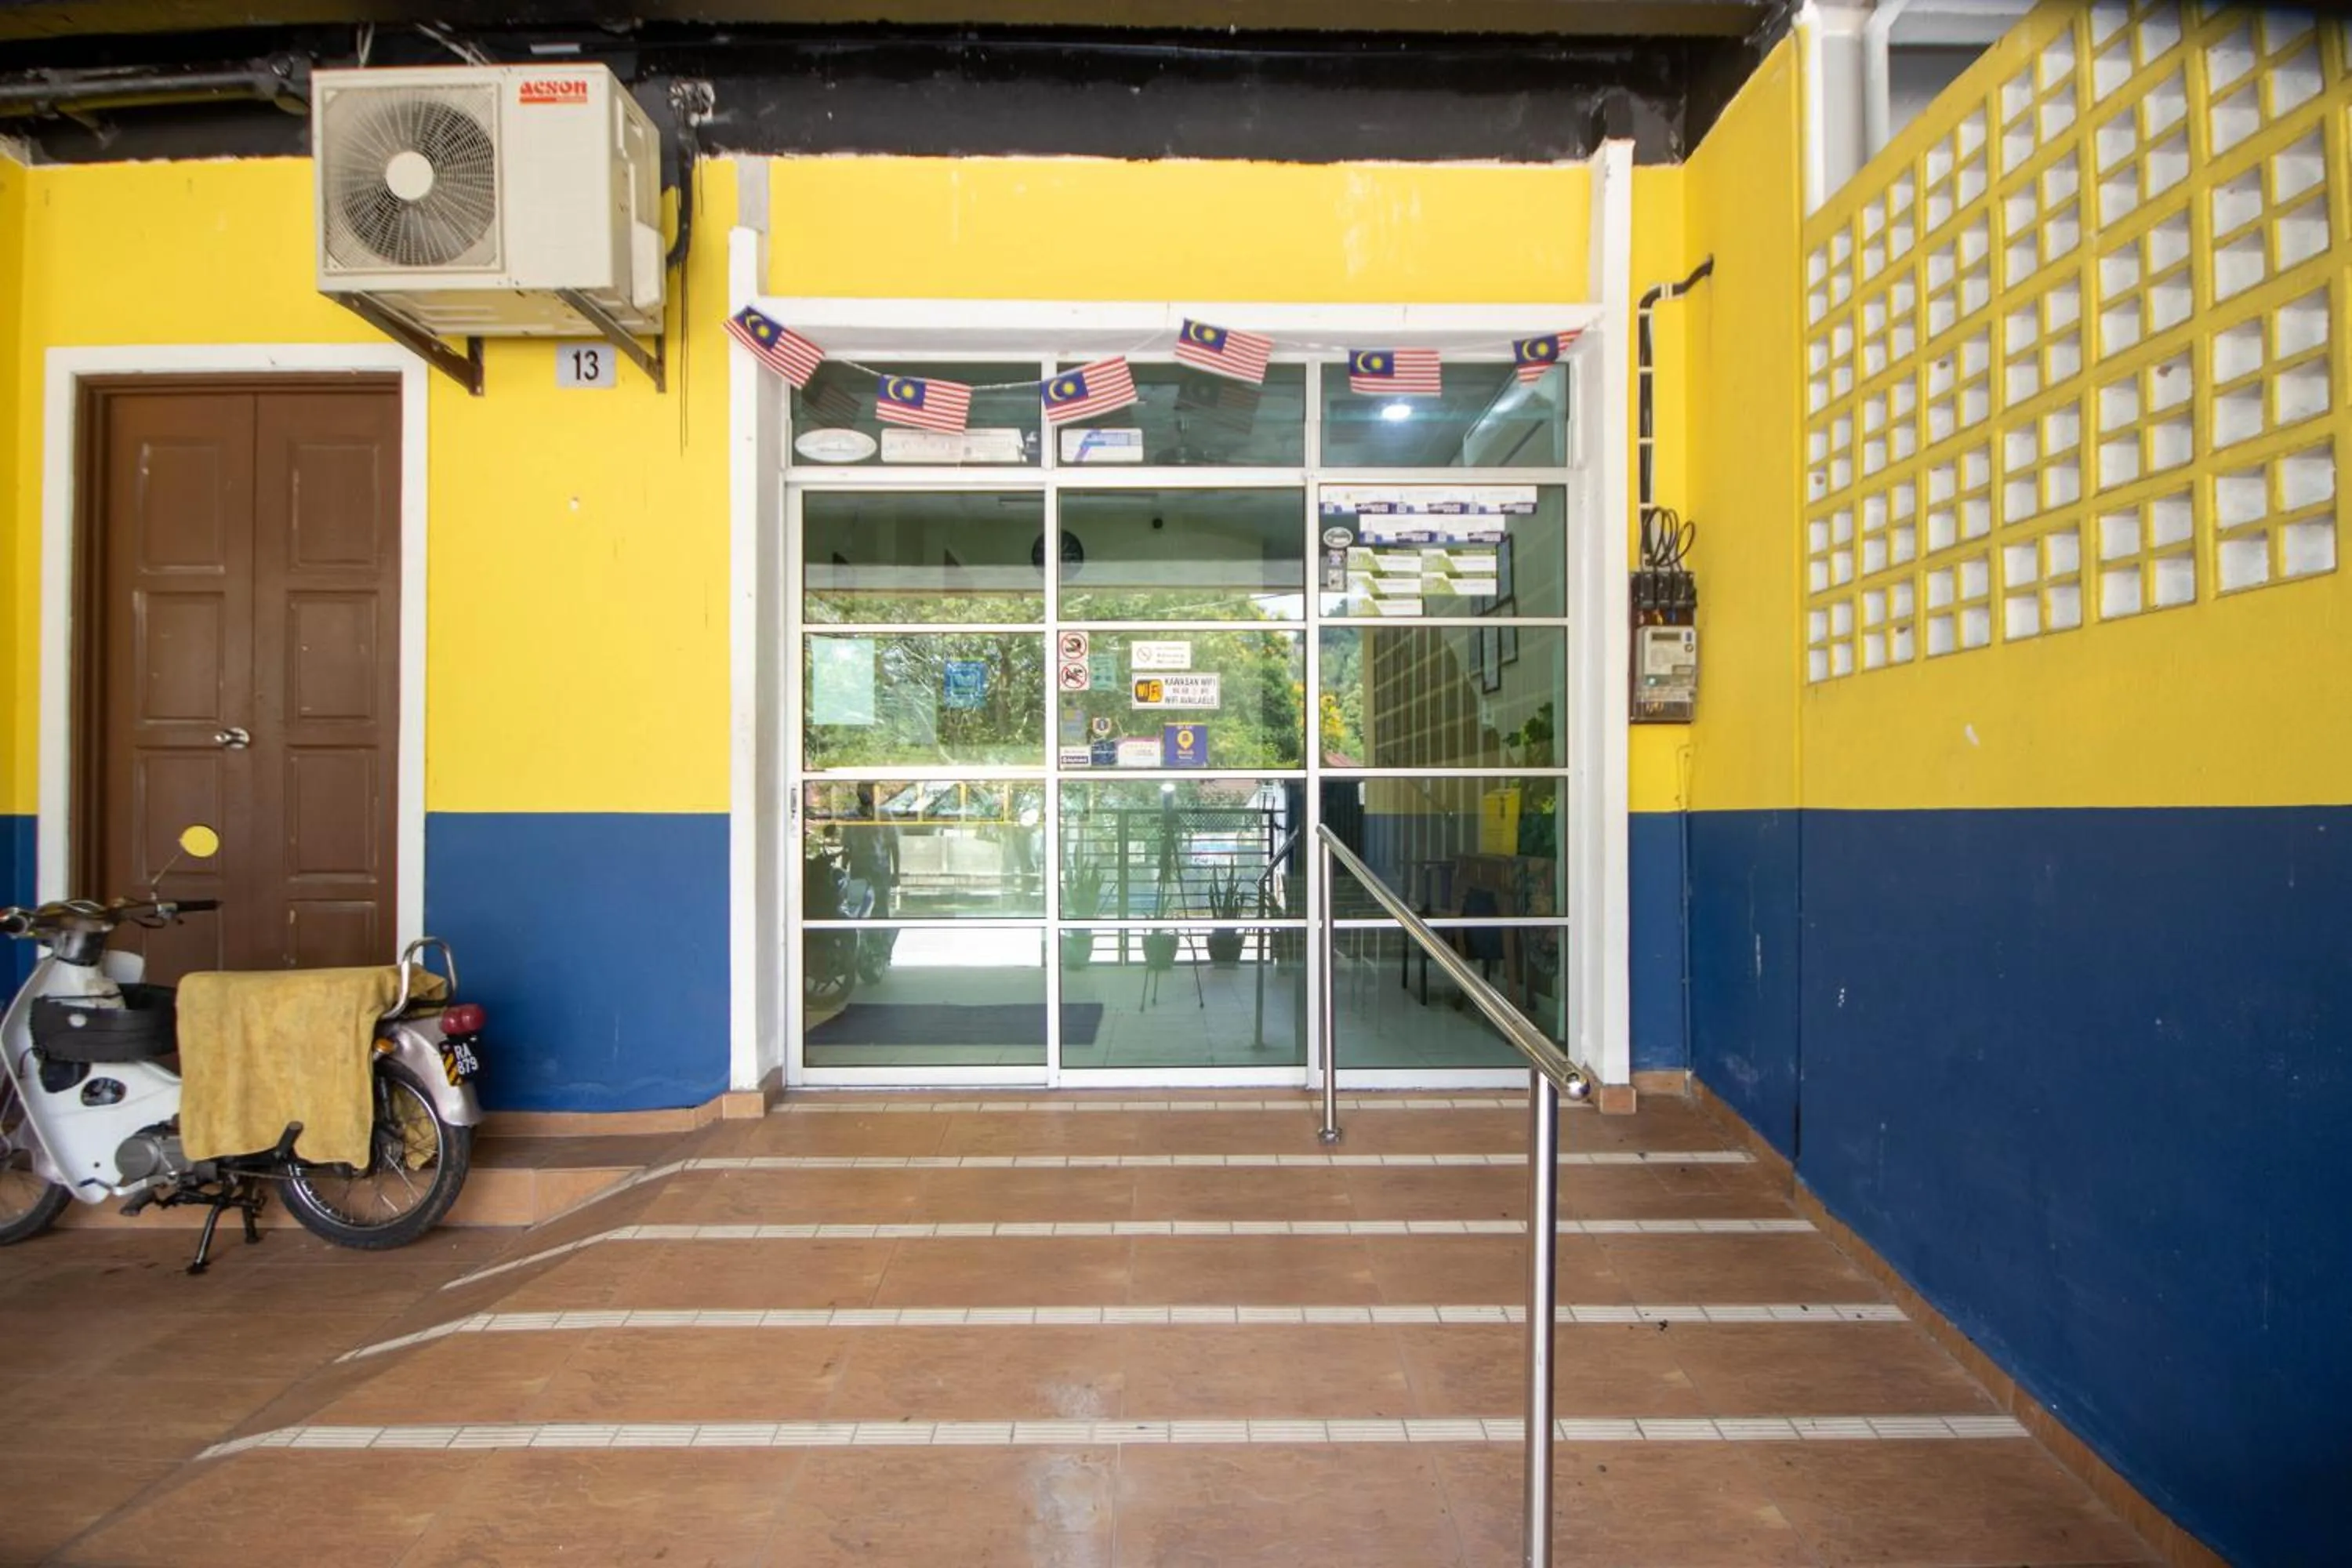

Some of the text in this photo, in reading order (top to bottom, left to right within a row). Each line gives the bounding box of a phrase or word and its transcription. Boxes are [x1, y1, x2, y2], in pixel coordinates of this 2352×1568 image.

[573, 350, 599, 381] 13
[454, 1043, 471, 1060] RA
[457, 1056, 479, 1075] 879
